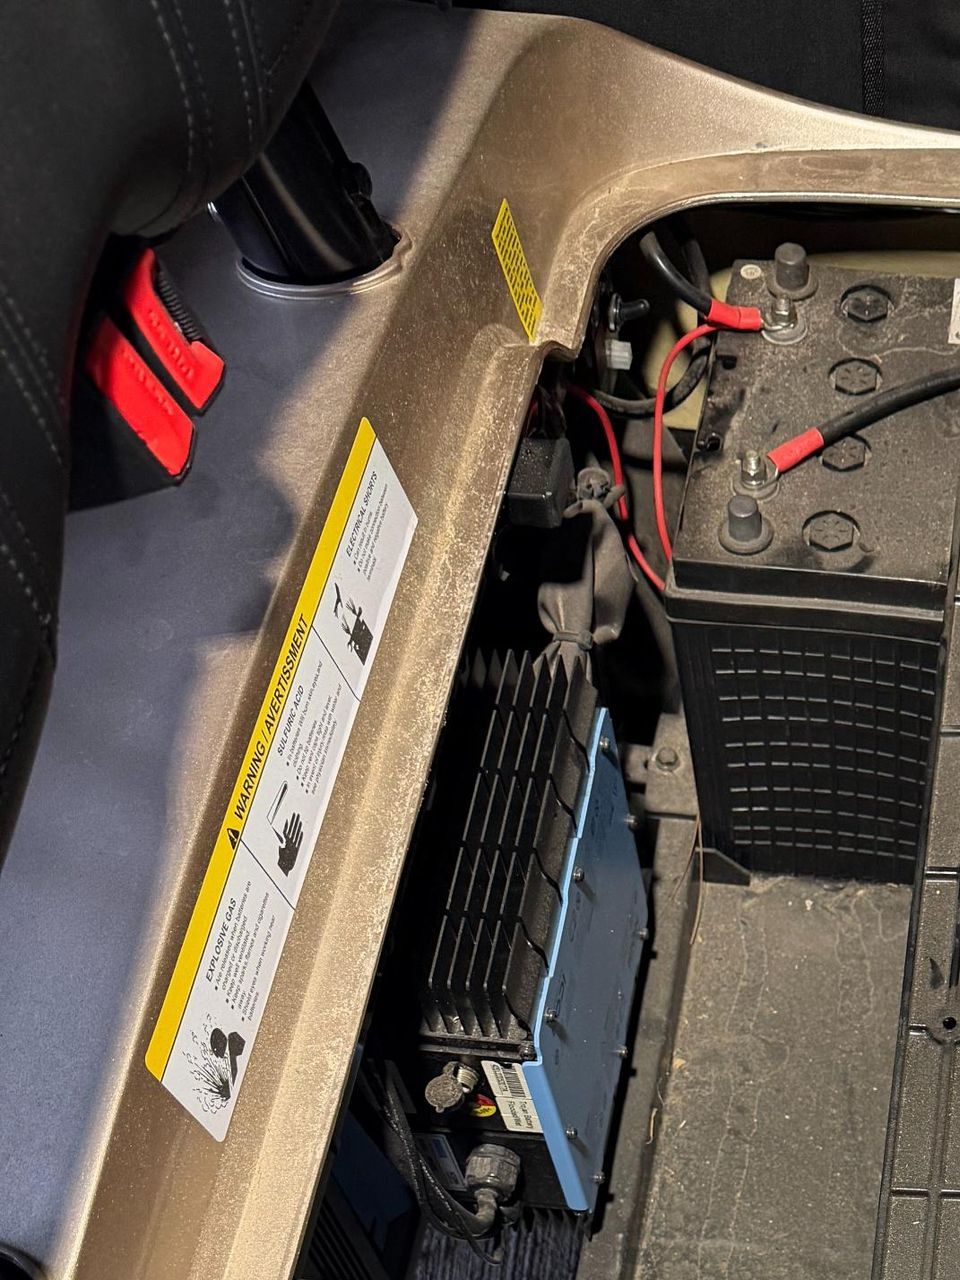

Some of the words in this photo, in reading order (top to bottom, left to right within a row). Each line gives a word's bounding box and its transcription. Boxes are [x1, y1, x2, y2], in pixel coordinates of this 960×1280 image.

[345, 506, 366, 557] ELECTRICAL
[363, 470, 377, 506] SHORTS
[234, 740, 265, 819] WARNING
[264, 613, 307, 734] AVERTISSMENT
[277, 707, 296, 756] SULFURIC
[293, 684, 303, 710] ACID
[205, 921, 228, 982] EXPLOSIVE
[225, 897, 236, 921] GAS
